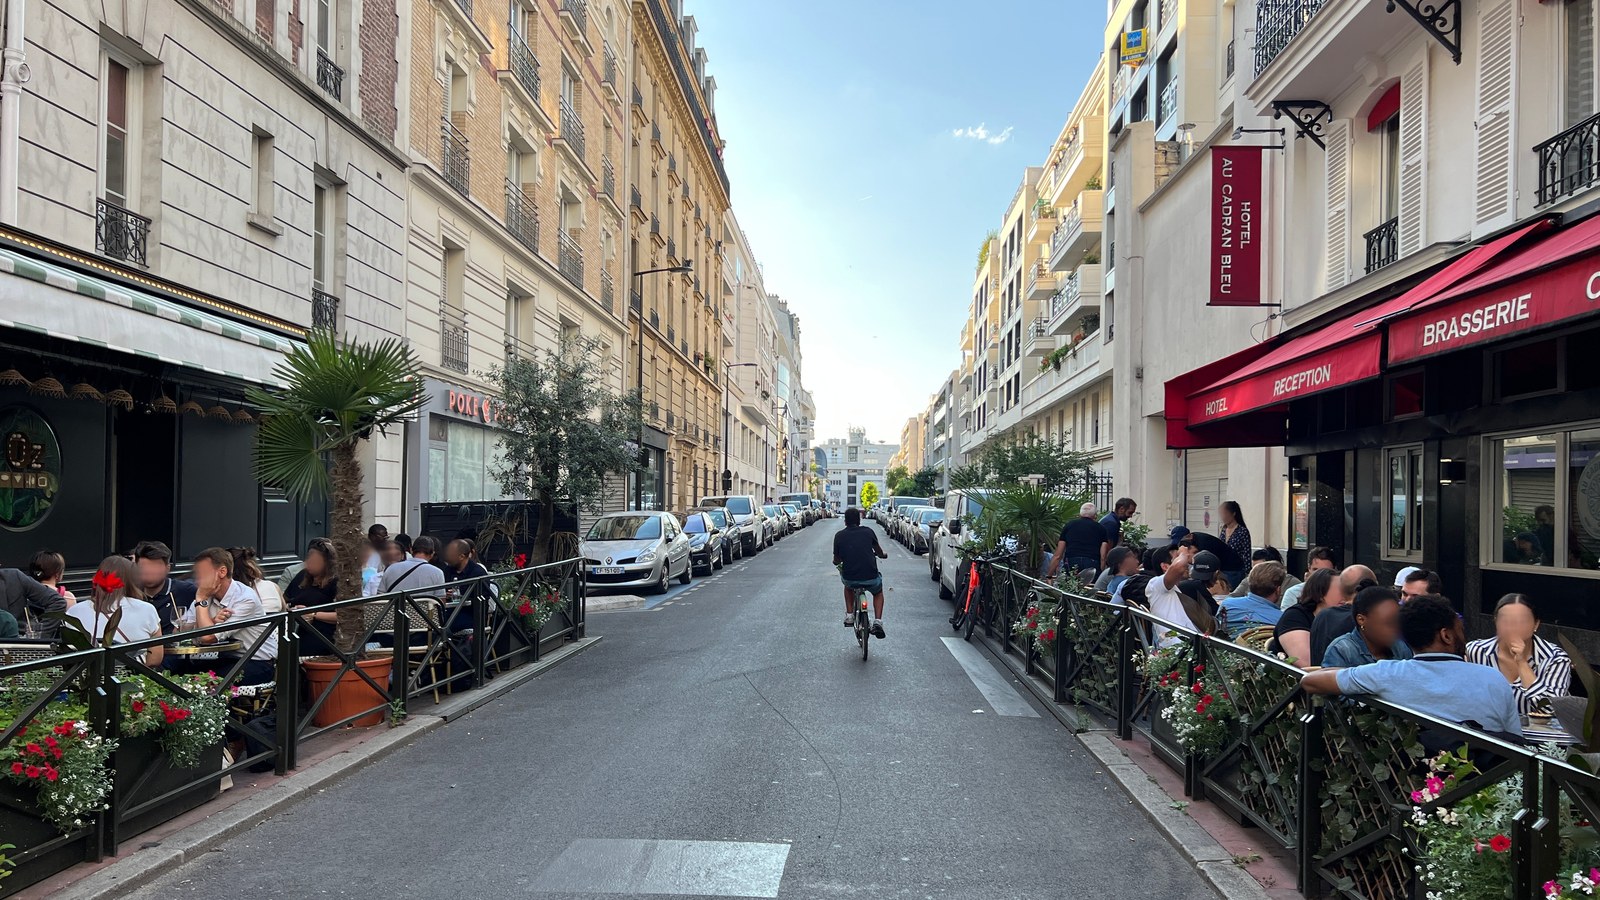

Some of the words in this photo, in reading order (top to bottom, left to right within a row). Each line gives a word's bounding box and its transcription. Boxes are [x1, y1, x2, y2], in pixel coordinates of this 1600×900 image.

[1222, 157, 1233, 178] AU
[1221, 184, 1233, 248] CADRAN
[1240, 201, 1251, 249] HOTEL
[1220, 254, 1231, 294] BLEU
[1423, 292, 1532, 347] BRASSERIE
[449, 388, 479, 417] POKE
[1205, 397, 1228, 416] HOTEL
[1273, 363, 1332, 397] RECEPTION
